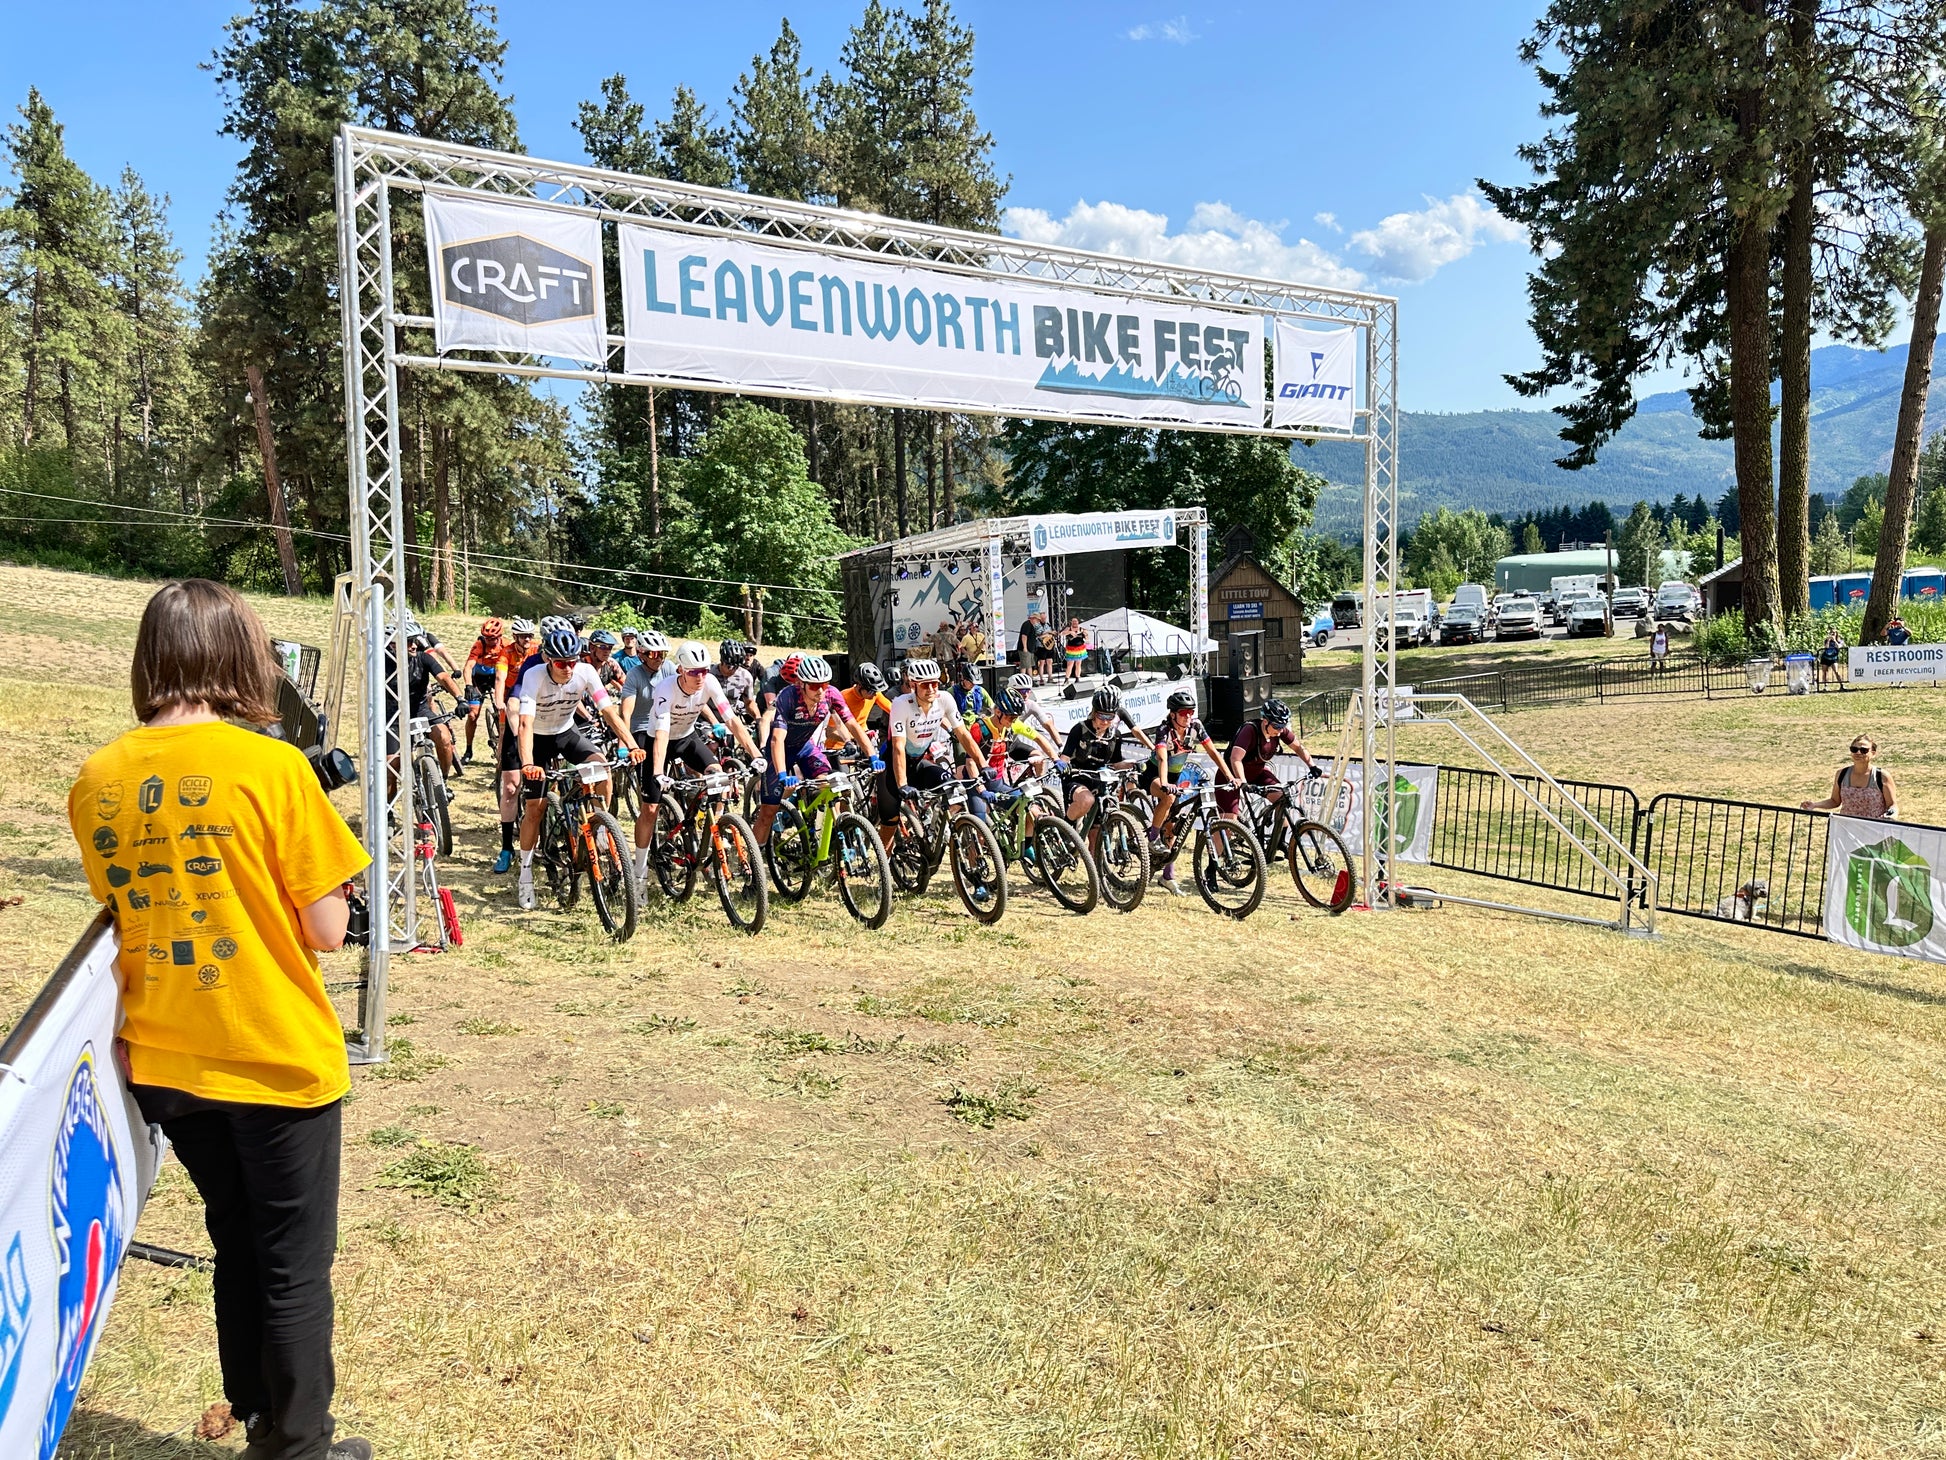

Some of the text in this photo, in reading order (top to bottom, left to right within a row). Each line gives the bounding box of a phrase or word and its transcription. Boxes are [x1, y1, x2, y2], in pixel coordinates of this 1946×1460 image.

[451, 257, 588, 305] CRAFT
[643, 249, 1249, 382] LEAVENWORTH BIKE FEST
[1279, 382, 1352, 401] GIANT
[1049, 519, 1159, 540] LEAVENWORTH BIKE FEST
[1221, 588, 1269, 600] LITTLE TOW
[1866, 649, 1944, 663] RESTROOMS
[1874, 668, 1895, 677] (BEER
[1896, 667, 1936, 676] RECYCLING)
[1124, 696, 1146, 709] FINISH
[1147, 693, 1162, 705] LINE
[182, 778, 209, 789] ICICLE
[180, 823, 235, 841] ARLBERG
[132, 836, 169, 848] GIANT
[186, 860, 221, 872] CRAFT
